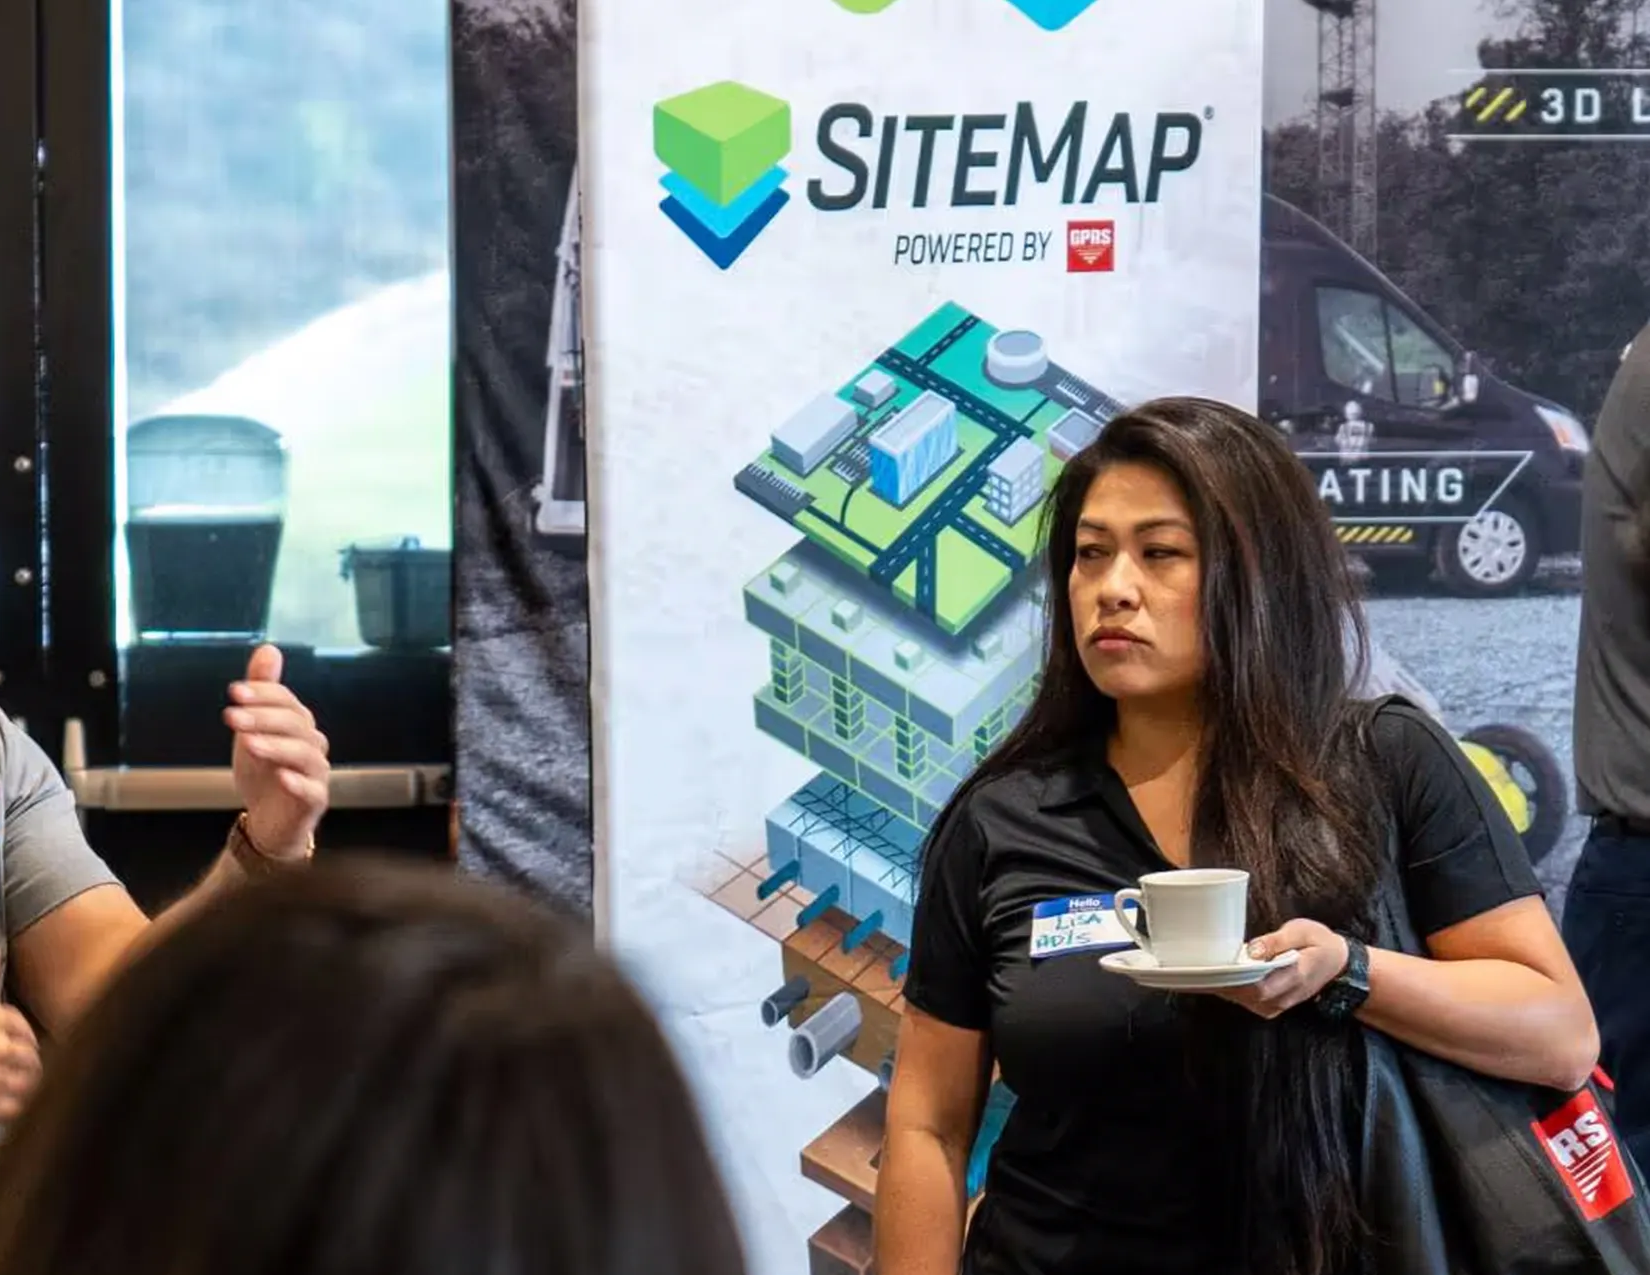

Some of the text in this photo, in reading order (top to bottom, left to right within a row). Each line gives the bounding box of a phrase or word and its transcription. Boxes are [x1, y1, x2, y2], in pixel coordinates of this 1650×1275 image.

[1540, 87, 1601, 123] 3D
[894, 229, 1053, 265] POWERED BY
[1069, 897, 1101, 908] Hello
